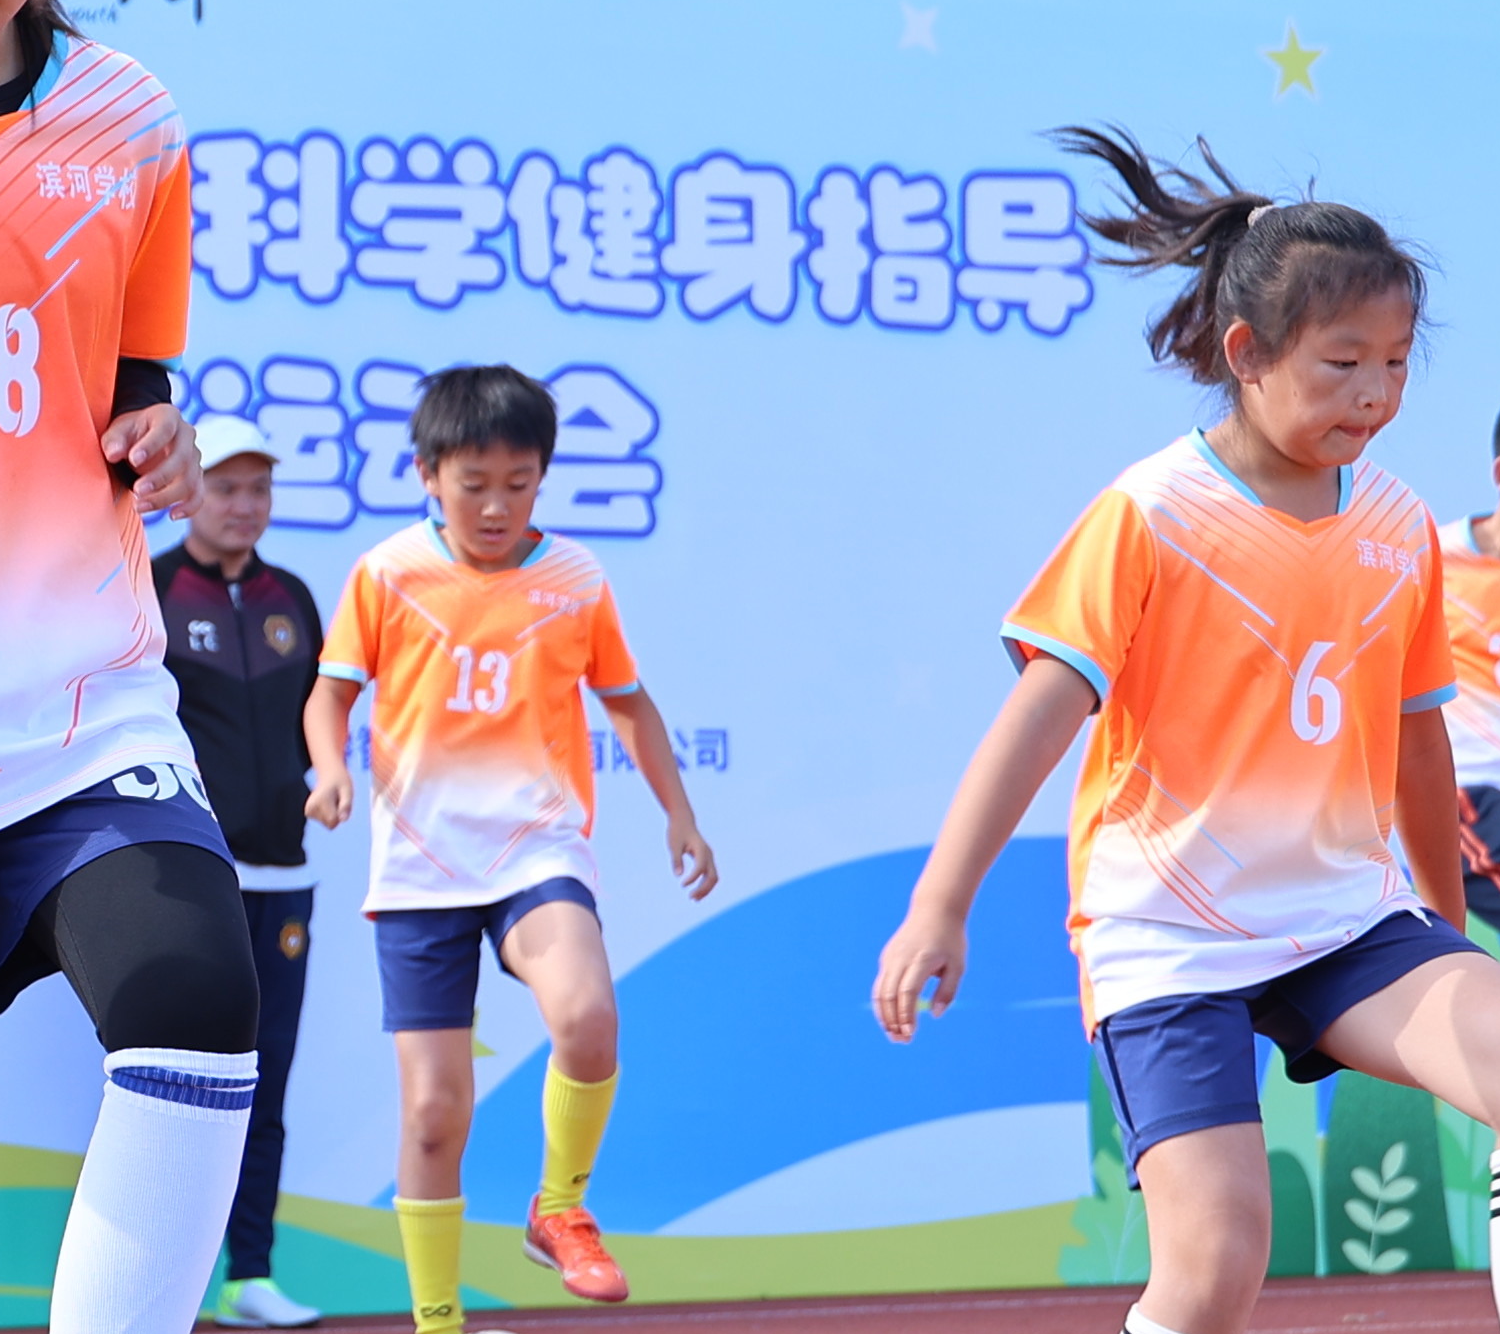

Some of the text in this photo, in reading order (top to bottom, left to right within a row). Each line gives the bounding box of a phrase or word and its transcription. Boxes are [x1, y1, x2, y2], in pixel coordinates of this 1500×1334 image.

[35, 162, 138, 211] 滨河学校
[445, 643, 511, 715] 13
[1290, 639, 1343, 747] 6
